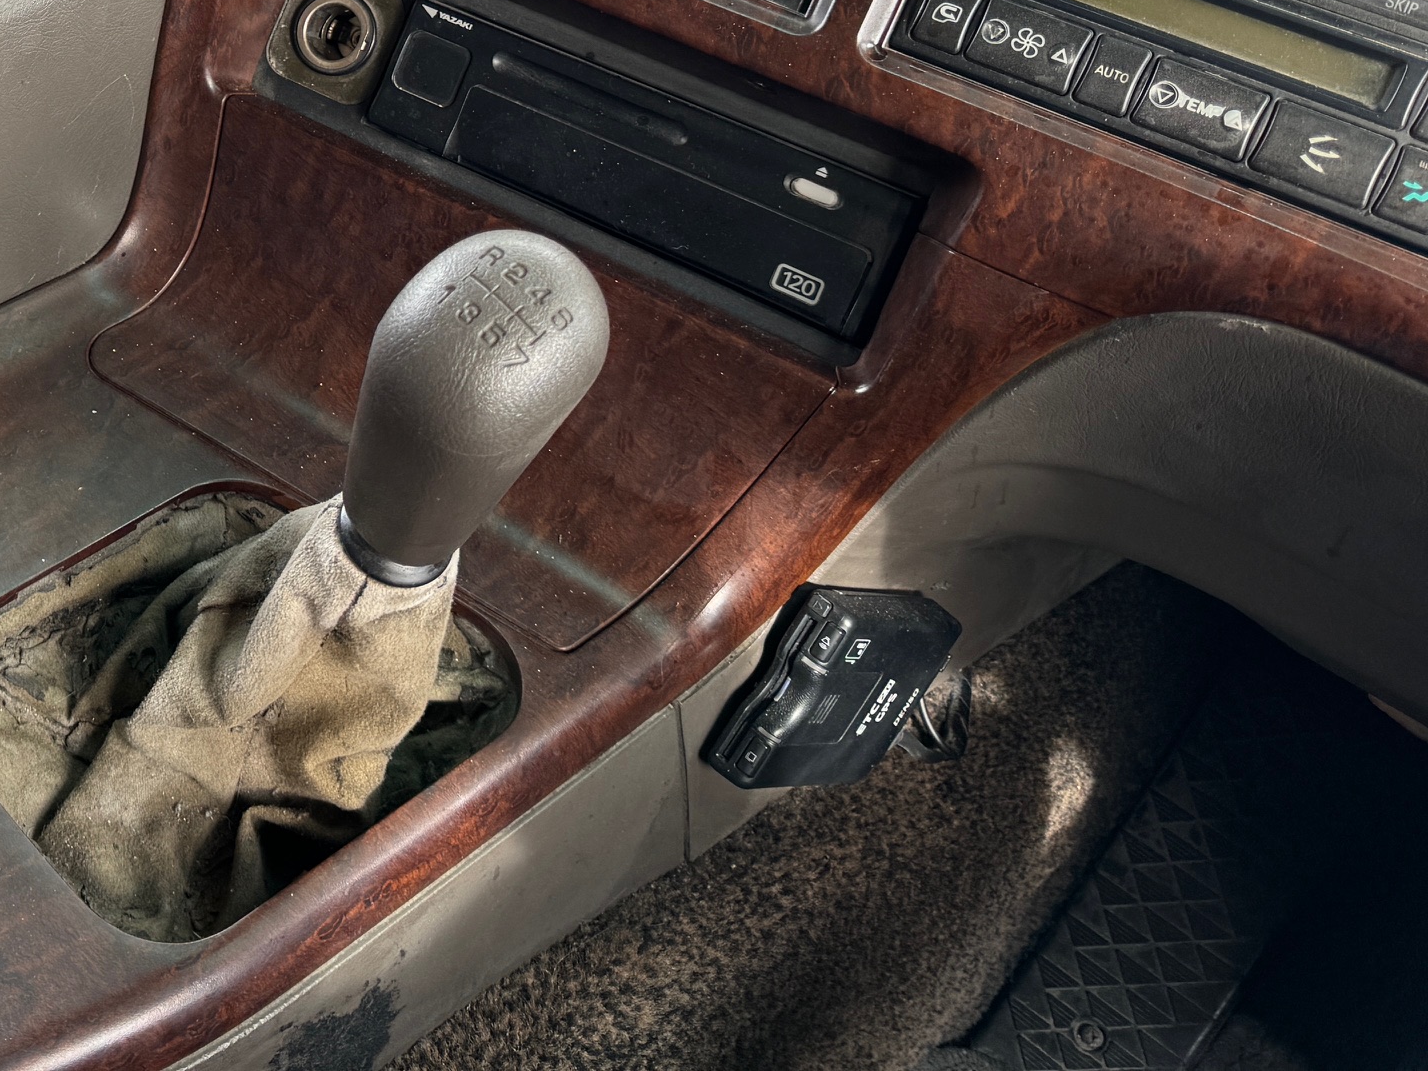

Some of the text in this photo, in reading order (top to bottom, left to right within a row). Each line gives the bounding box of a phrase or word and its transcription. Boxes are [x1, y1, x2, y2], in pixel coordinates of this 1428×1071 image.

[439, 11, 474, 31] YAZAKI
[1094, 64, 1130, 84] AUTO
[1177, 92, 1226, 119] TEMP
[479, 245, 505, 267] R
[501, 262, 528, 287] 2
[525, 286, 552, 306] 4
[783, 271, 816, 297] 120
[437, 285, 457, 305] 1
[456, 302, 482, 325] 3
[500, 342, 529, 367] 7
[893, 687, 919, 726] DENSO
